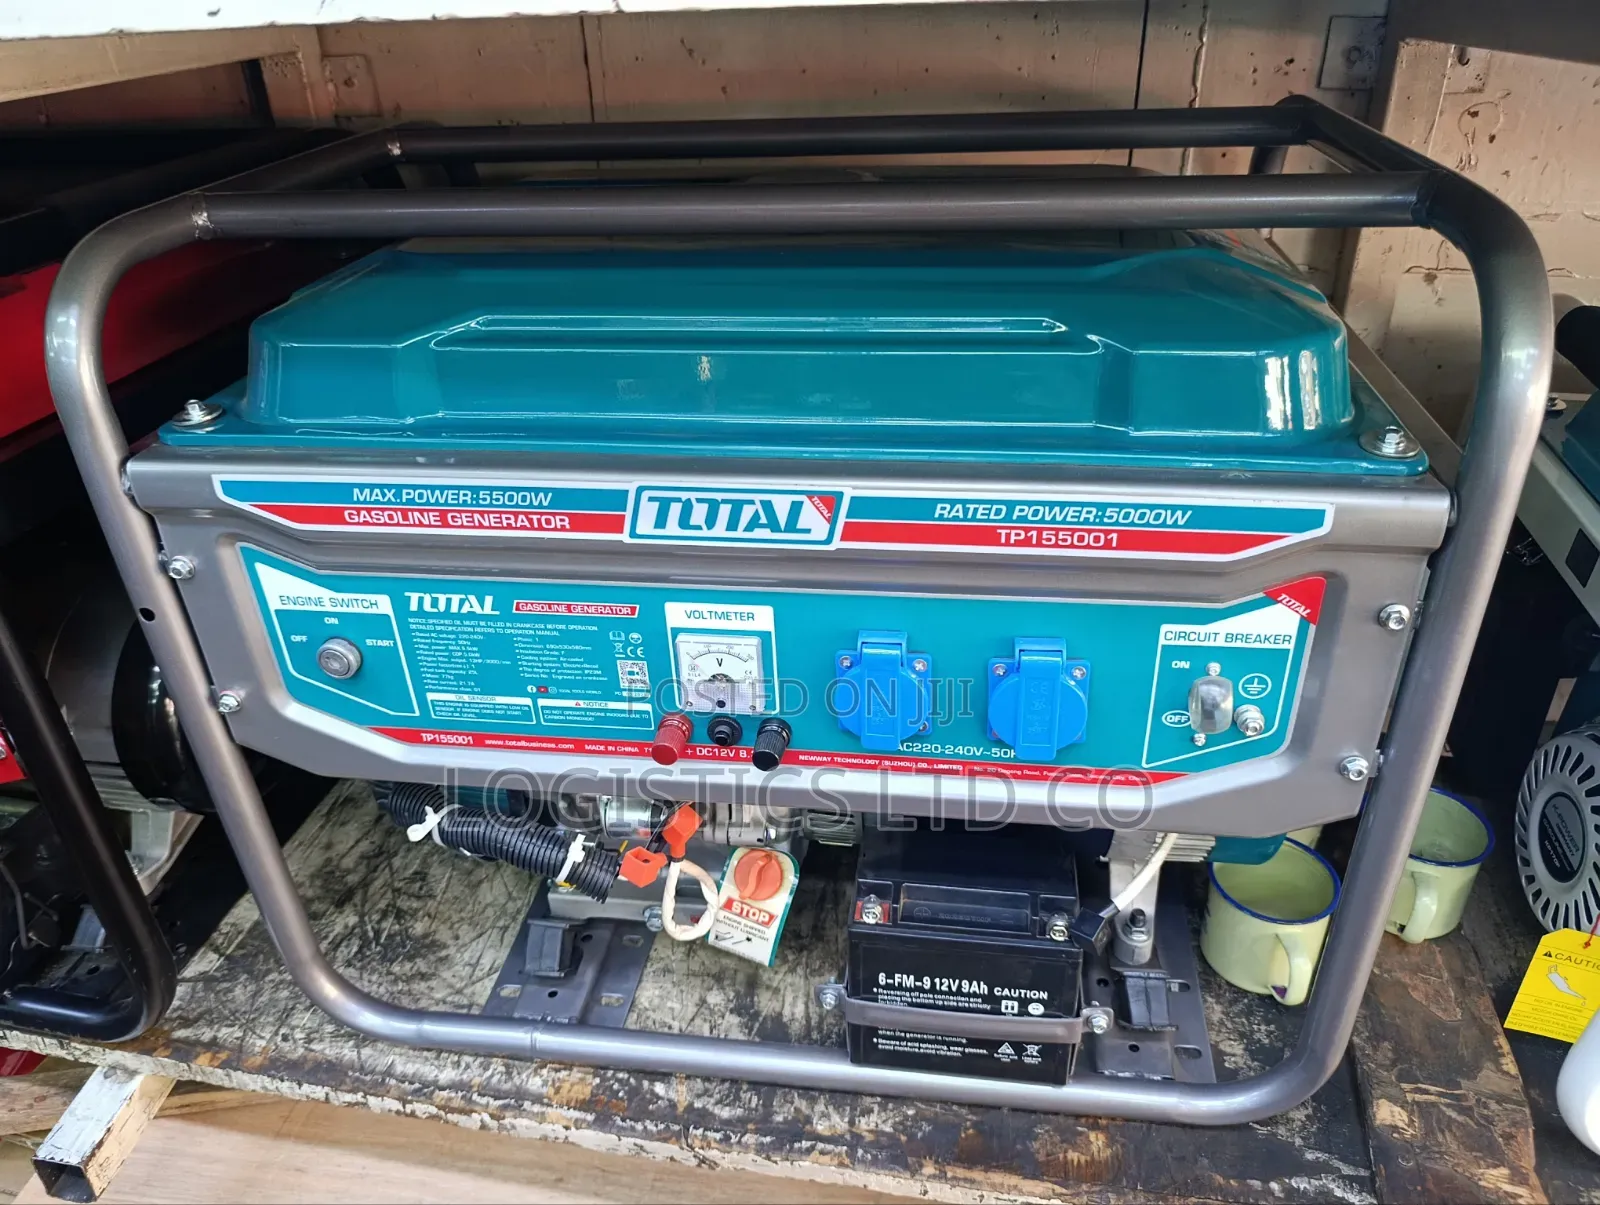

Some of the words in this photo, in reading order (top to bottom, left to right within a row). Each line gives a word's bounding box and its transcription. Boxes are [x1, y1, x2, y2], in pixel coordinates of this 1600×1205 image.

[352, 487, 552, 507] MAX.POWER:5500W
[811, 495, 832, 519] TOTAL
[934, 503, 1007, 519] RATED
[1012, 505, 1192, 525] POWER:5000W
[344, 509, 442, 526] GASOLINE
[447, 512, 571, 529] GENERATOR
[647, 496, 812, 534] TOTAL
[997, 529, 1118, 547] TP155001
[279, 595, 326, 607] ENGINE
[328, 597, 379, 609] SWITCH
[404, 592, 500, 615] TOTAL
[519, 603, 568, 613] GASOLINE
[570, 604, 632, 615] GENERATOR
[1276, 593, 1311, 618] TOTAL
[324, 617, 339, 625] ON
[684, 609, 755, 621] VOLTMETER
[290, 635, 308, 643] OFF
[365, 639, 394, 647] START
[1164, 630, 1220, 643] CIRCUIT
[1224, 632, 1292, 645] BREAKER
[716, 658, 723, 667] V
[1171, 660, 1190, 669] ON
[583, 701, 609, 709] NOTICE
[1167, 715, 1189, 724] OFF
[421, 733, 473, 744] TP155001
[484, 739, 574, 749] www.totalbusiness.com
[696, 747, 735, 757] DC12V
[798, 754, 832, 762] NEWWAY
[833, 756, 880, 765] TECHNOLOGY
[881, 759, 915, 768] (SUZHOU)
[933, 763, 963, 771] LIMITED
[731, 901, 770, 923] STOP
[878, 972, 930, 990] 6-FM-9
[993, 986, 1048, 1000] CAUTION
